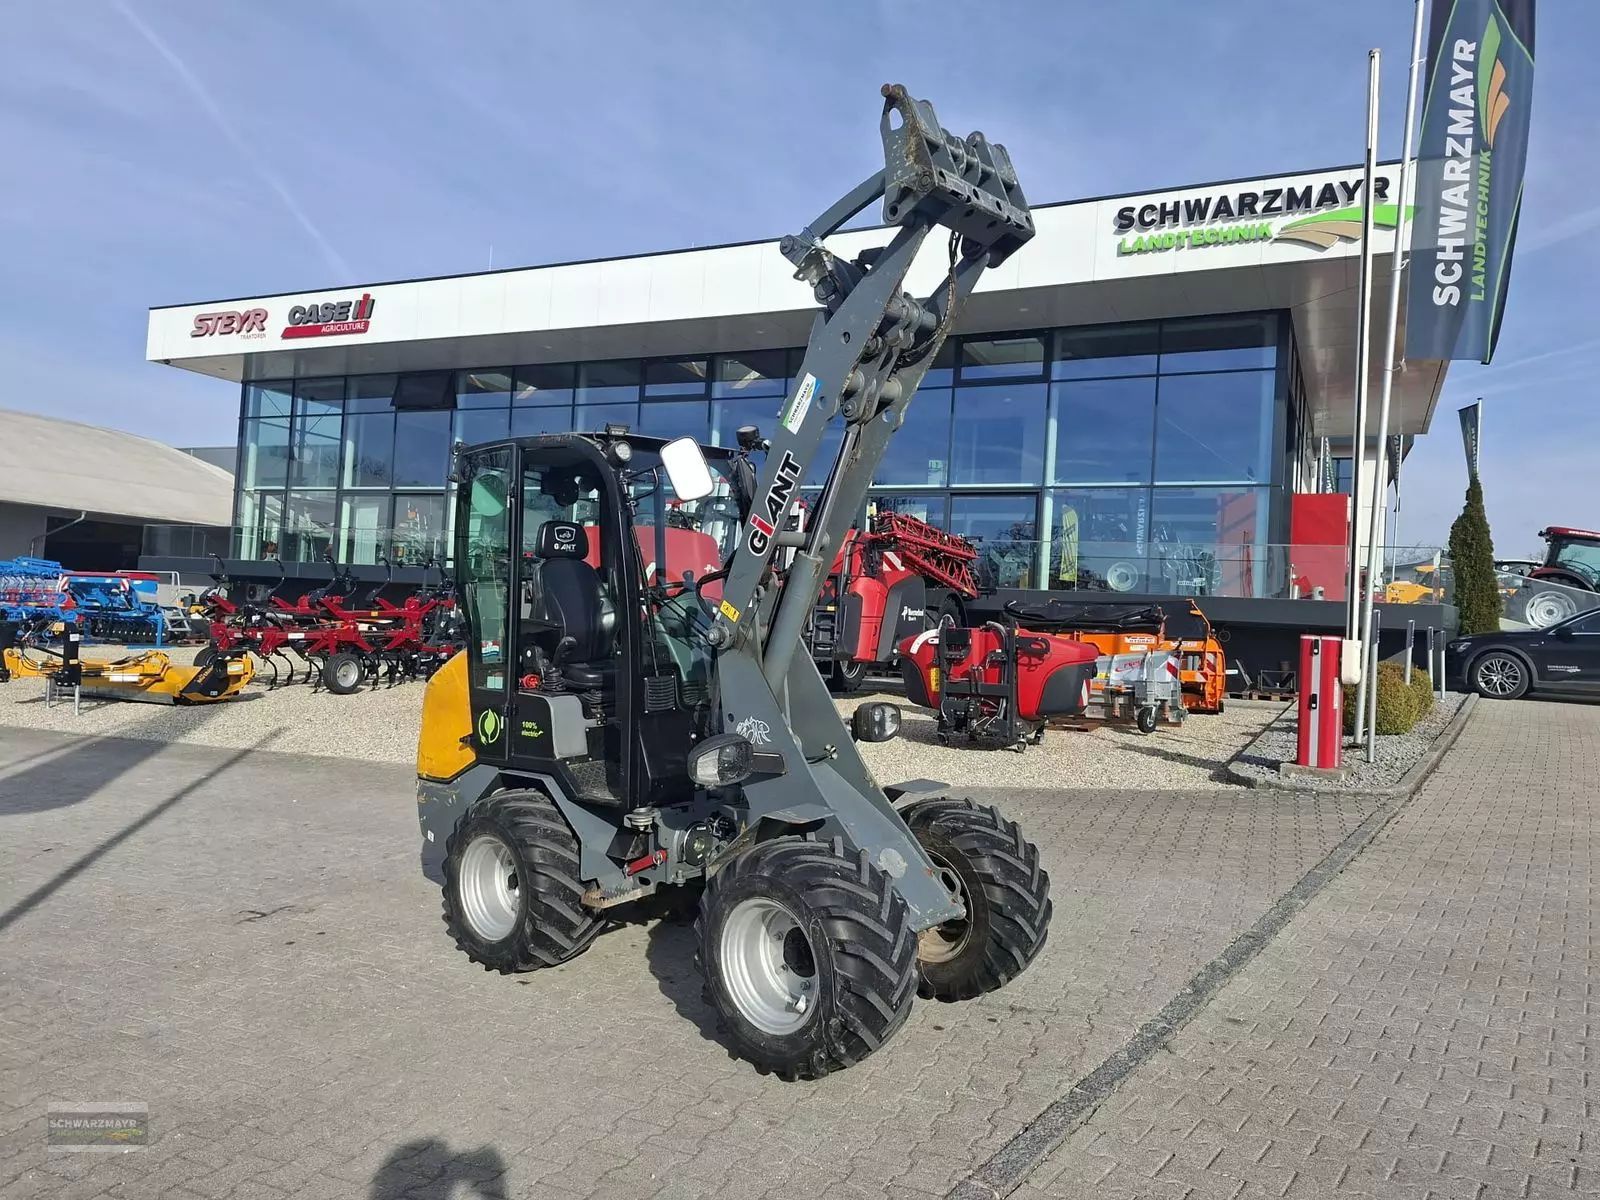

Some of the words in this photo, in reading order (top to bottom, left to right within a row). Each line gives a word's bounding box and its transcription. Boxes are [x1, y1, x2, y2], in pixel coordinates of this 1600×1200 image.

[1432, 38, 1477, 307] SCHWARZMAYR
[1116, 176, 1390, 230] SCHWARZMAYR
[1120, 221, 1273, 254] LANDTECHNIK
[1470, 149, 1491, 301] LANDTECHNIK
[190, 308, 268, 338] STEYR
[288, 300, 352, 325] CASE
[321, 321, 366, 333] AGRICULTURE
[748, 450, 801, 556] GIANT
